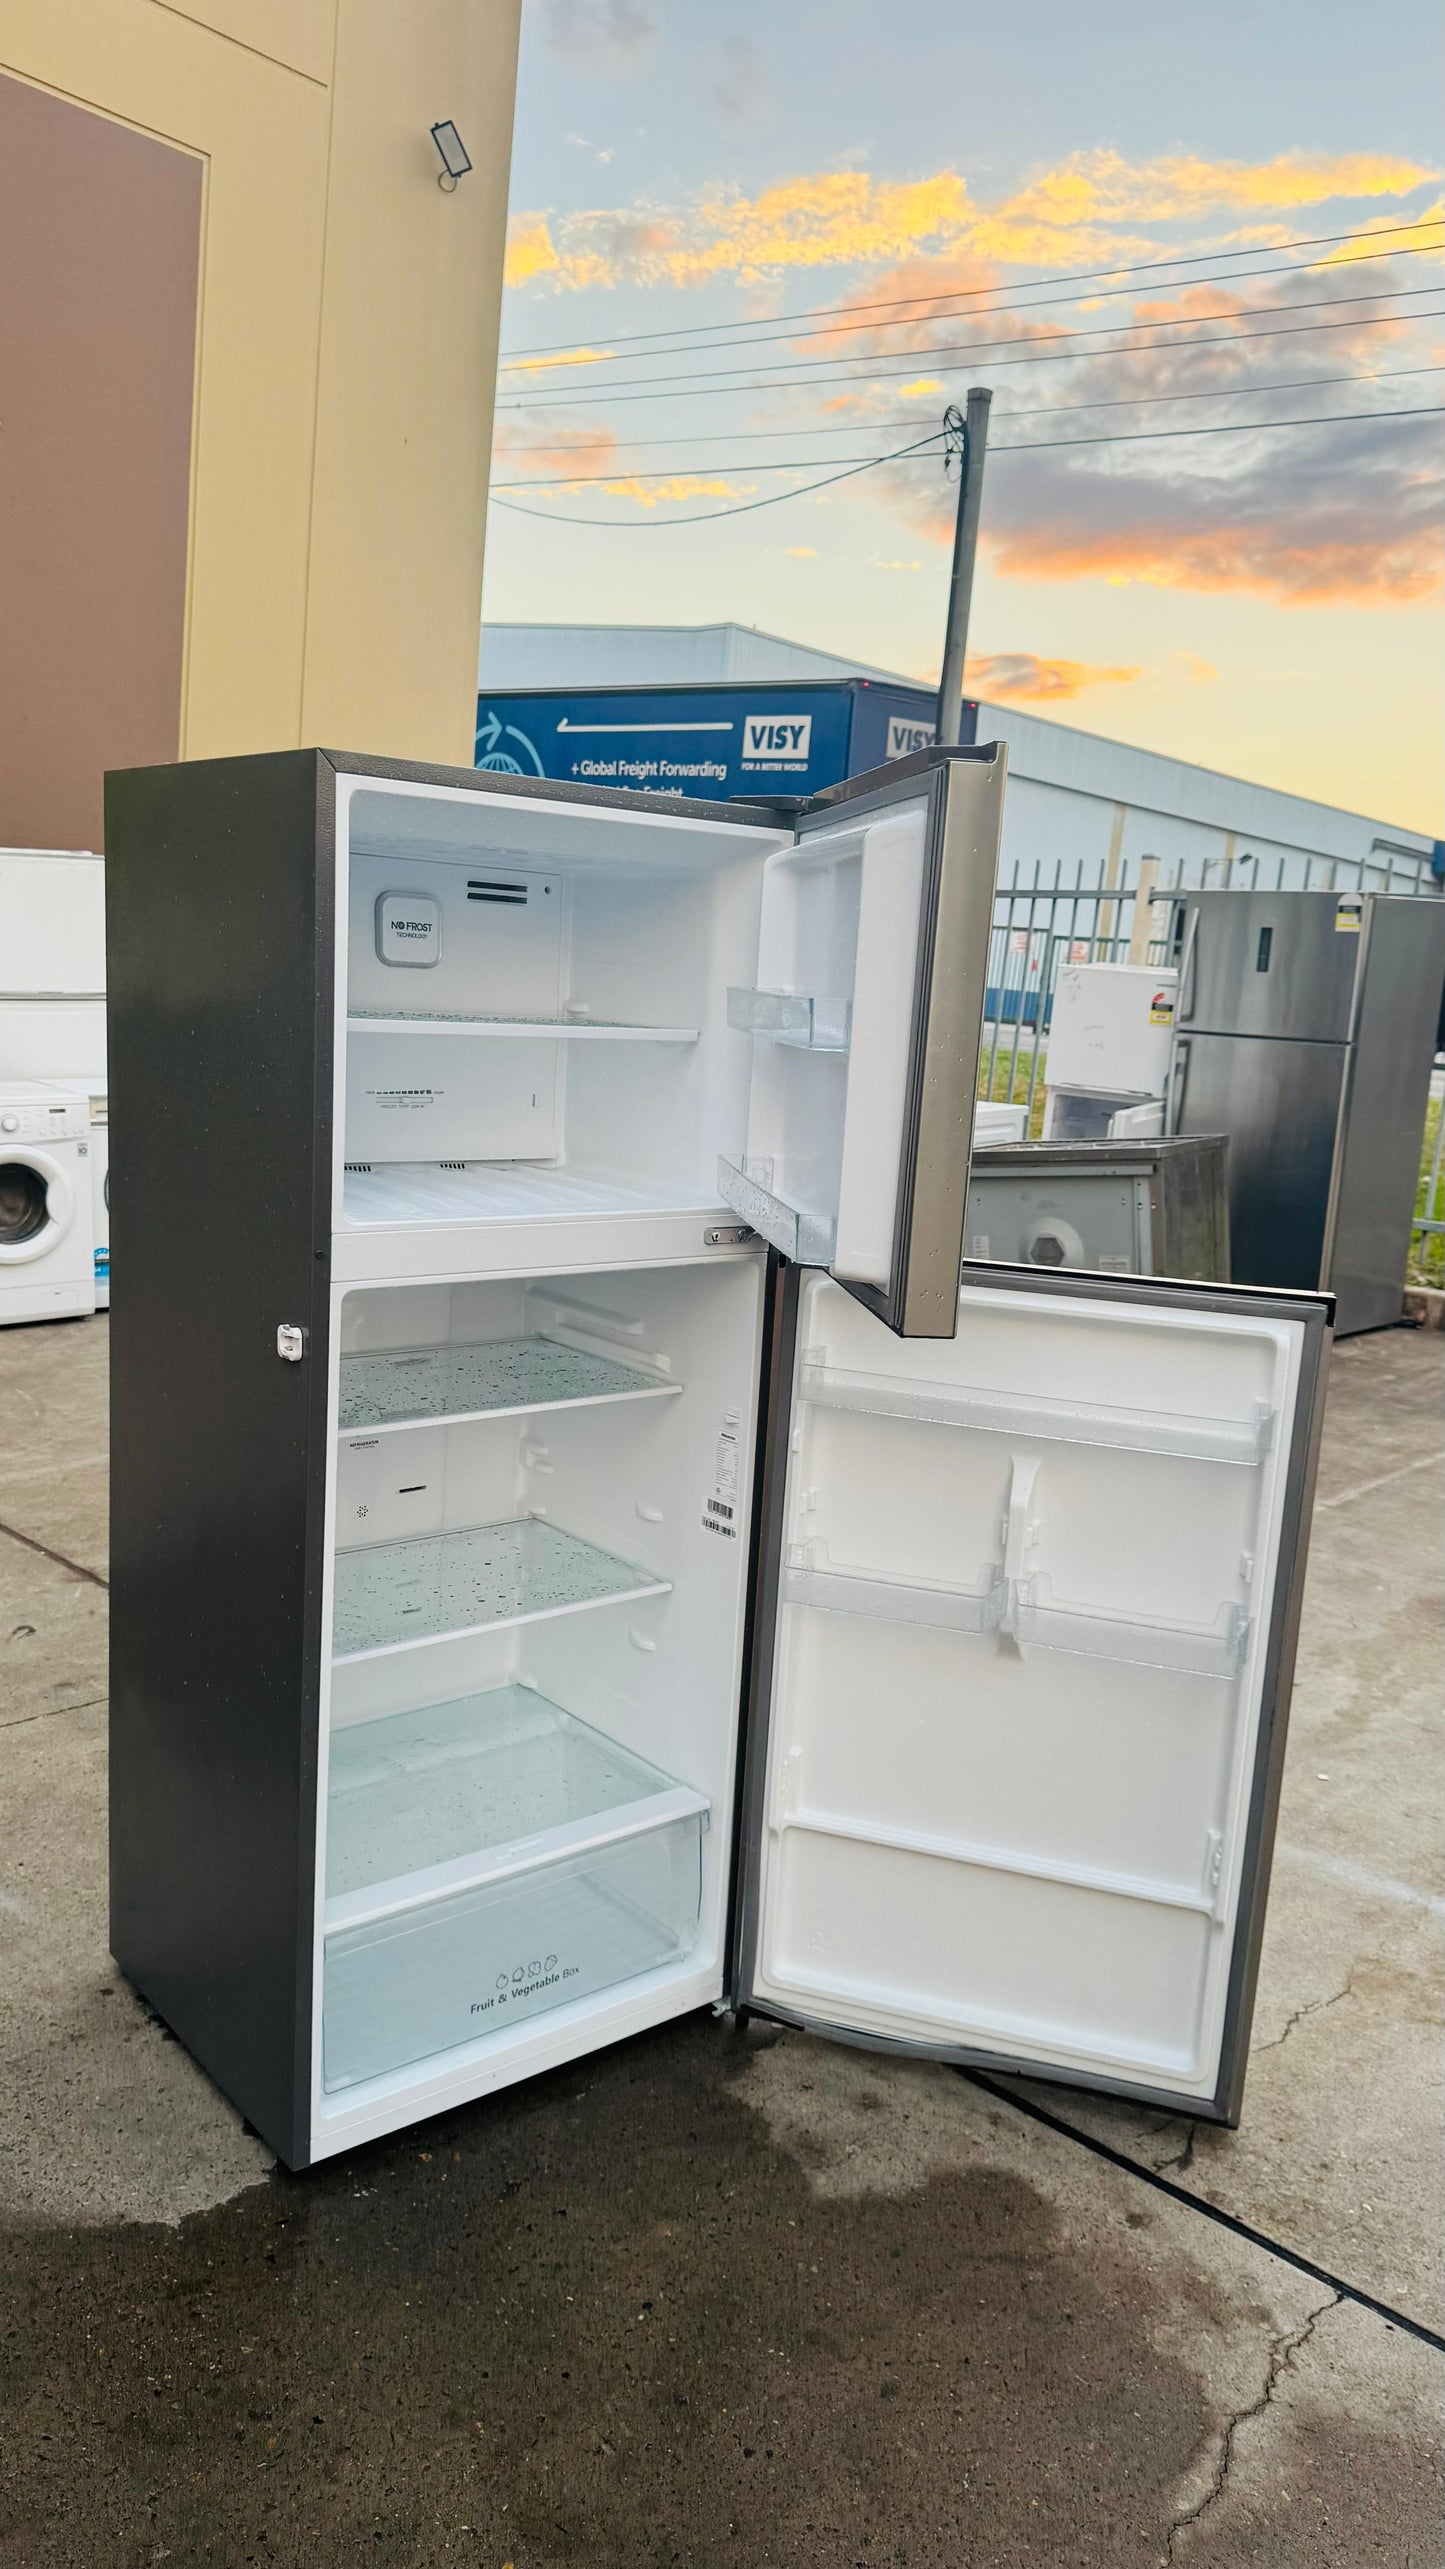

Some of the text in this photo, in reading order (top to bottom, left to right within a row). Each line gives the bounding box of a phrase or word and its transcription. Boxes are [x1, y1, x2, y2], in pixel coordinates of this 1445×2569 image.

[751, 725, 805, 750] VISY
[580, 760, 617, 776] Global
[618, 761, 658, 780] Freight
[659, 760, 727, 781] Forwarding
[391, 921, 432, 932] NO FROST
[470, 1966, 580, 2014] Fruit & Vegetable Box
